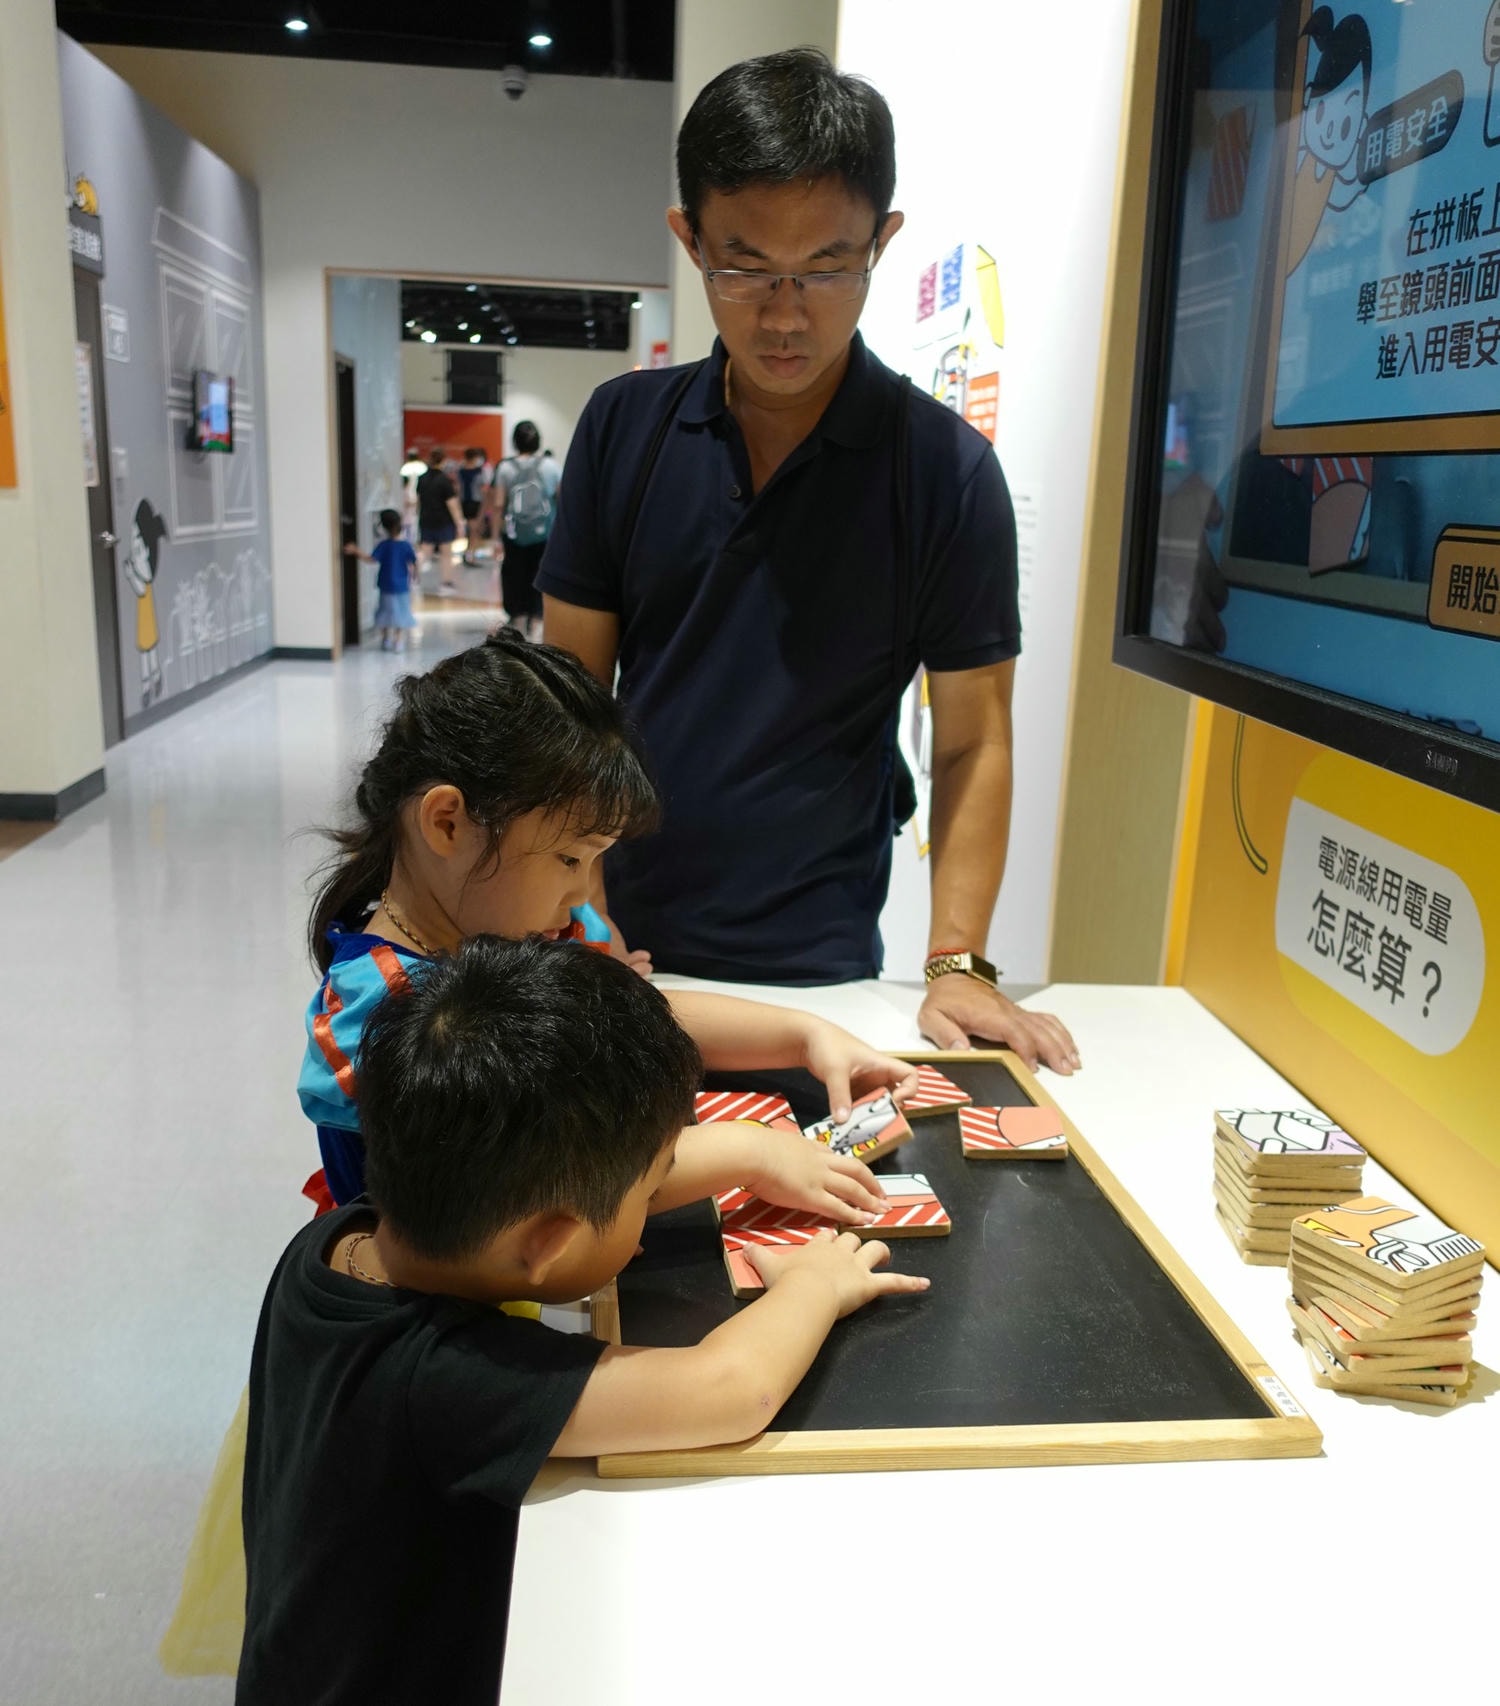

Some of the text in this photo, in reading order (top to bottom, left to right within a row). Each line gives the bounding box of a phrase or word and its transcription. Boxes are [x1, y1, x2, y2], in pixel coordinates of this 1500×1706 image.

[1364, 96, 1449, 173] 用電安全
[1406, 182, 1500, 256] 在拼板上
[1357, 249, 1500, 325] 舉至鏡頭前面
[1376, 316, 1500, 380] 進入用電安
[1318, 835, 1453, 945] 電源線用電量
